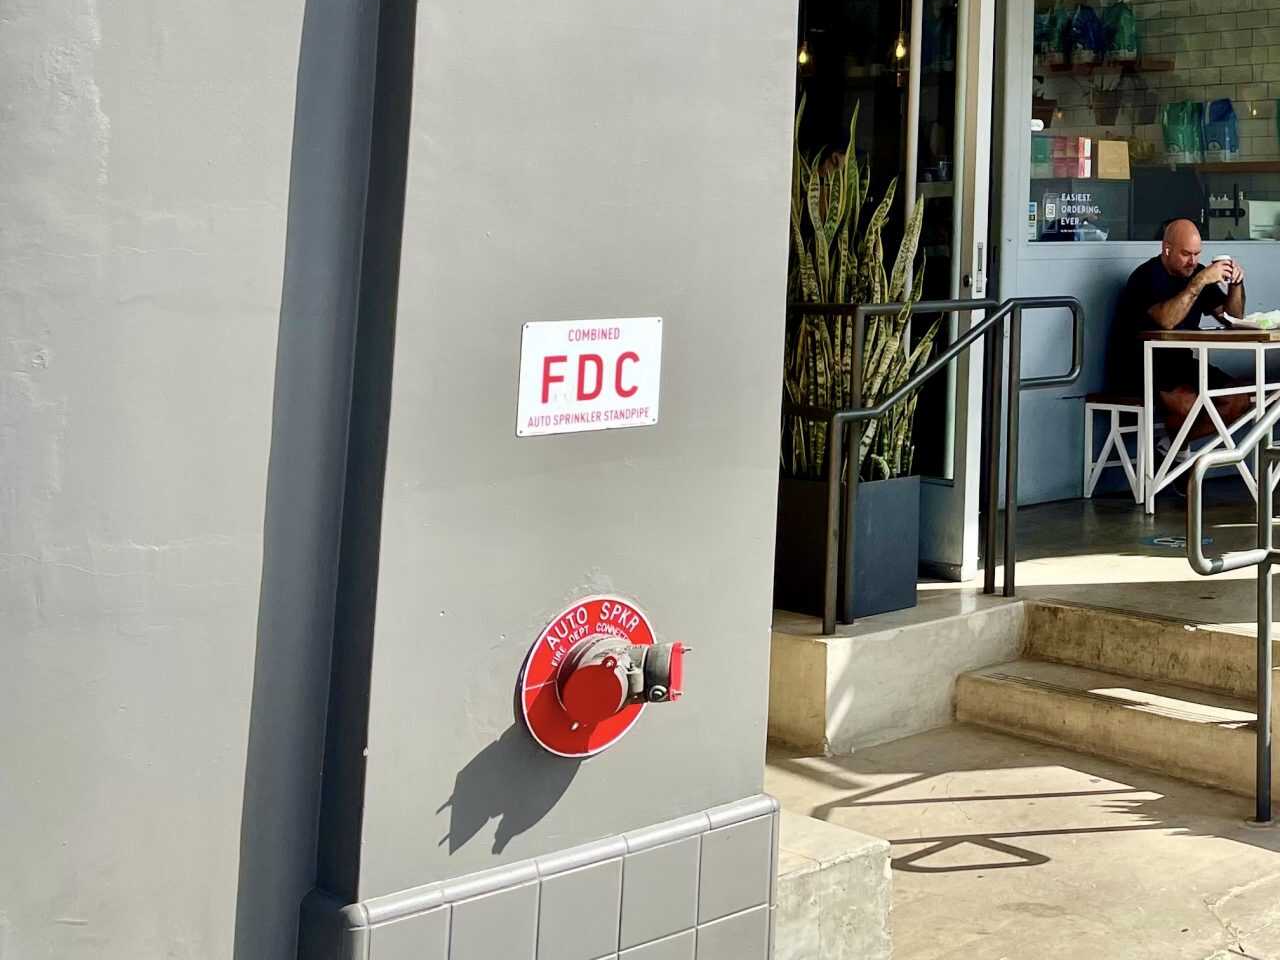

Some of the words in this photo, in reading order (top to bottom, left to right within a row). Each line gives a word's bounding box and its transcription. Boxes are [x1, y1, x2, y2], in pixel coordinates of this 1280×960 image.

[568, 327, 620, 342] COMBINED
[541, 351, 640, 404] FDC
[528, 415, 550, 428] AUTO
[553, 411, 602, 426] SPRINKLER
[603, 407, 649, 421] STANDPIPE
[547, 607, 588, 651] AUTO
[600, 601, 640, 632] SPKR
[568, 625, 589, 644] DEPT
